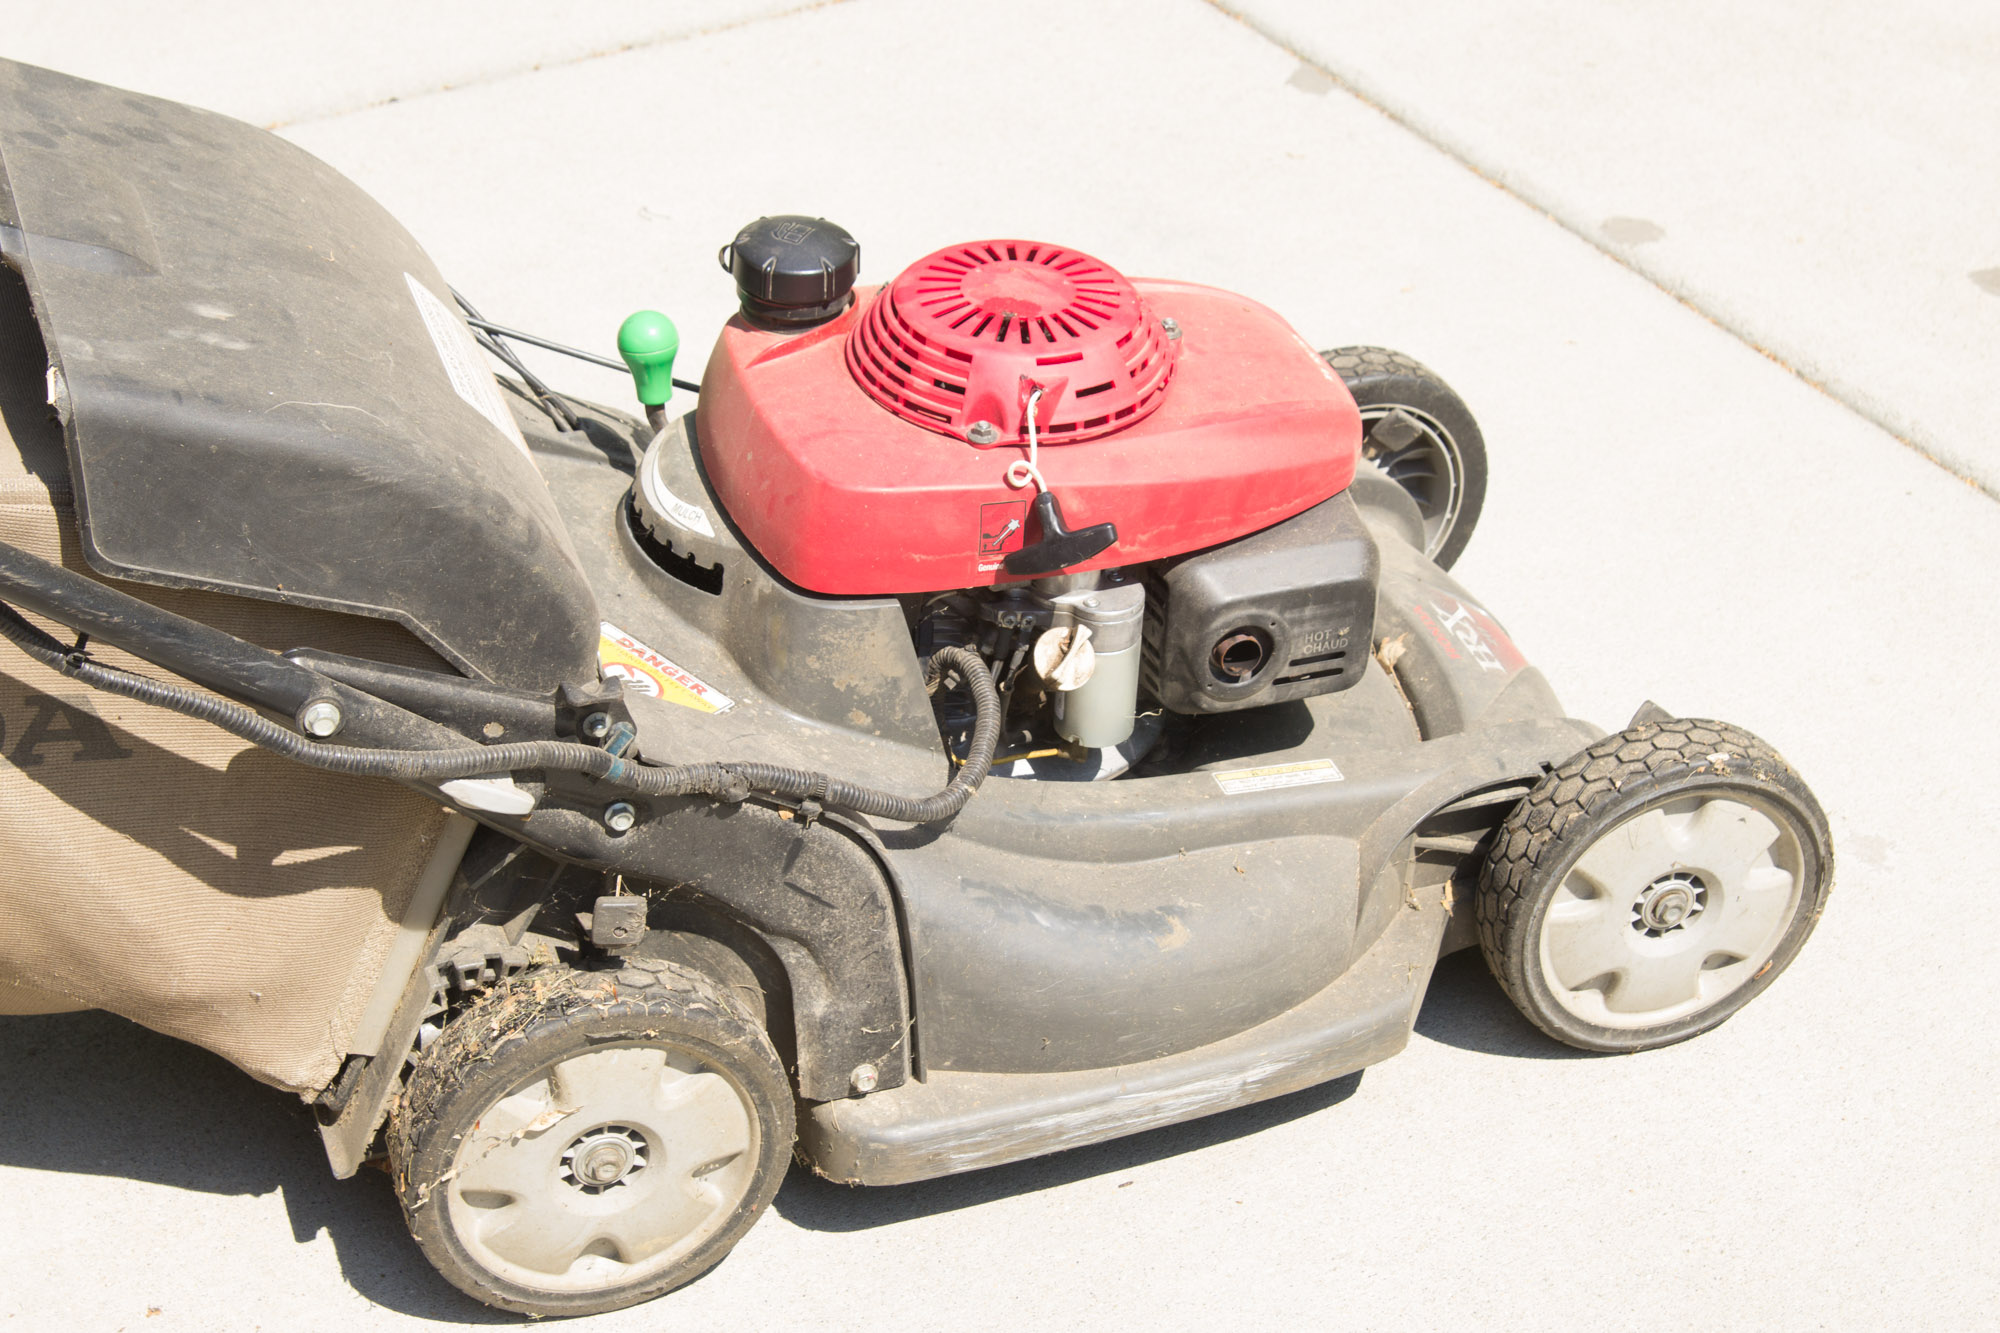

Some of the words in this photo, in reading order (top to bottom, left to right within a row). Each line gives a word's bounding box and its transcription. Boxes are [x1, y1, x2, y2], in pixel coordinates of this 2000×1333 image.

[671, 503, 702, 521] MULCH
[1305, 629, 1332, 643] HOT
[1303, 638, 1348, 654] CHAUD
[616, 637, 708, 696] DANGER
[0, 694, 133, 767] A
